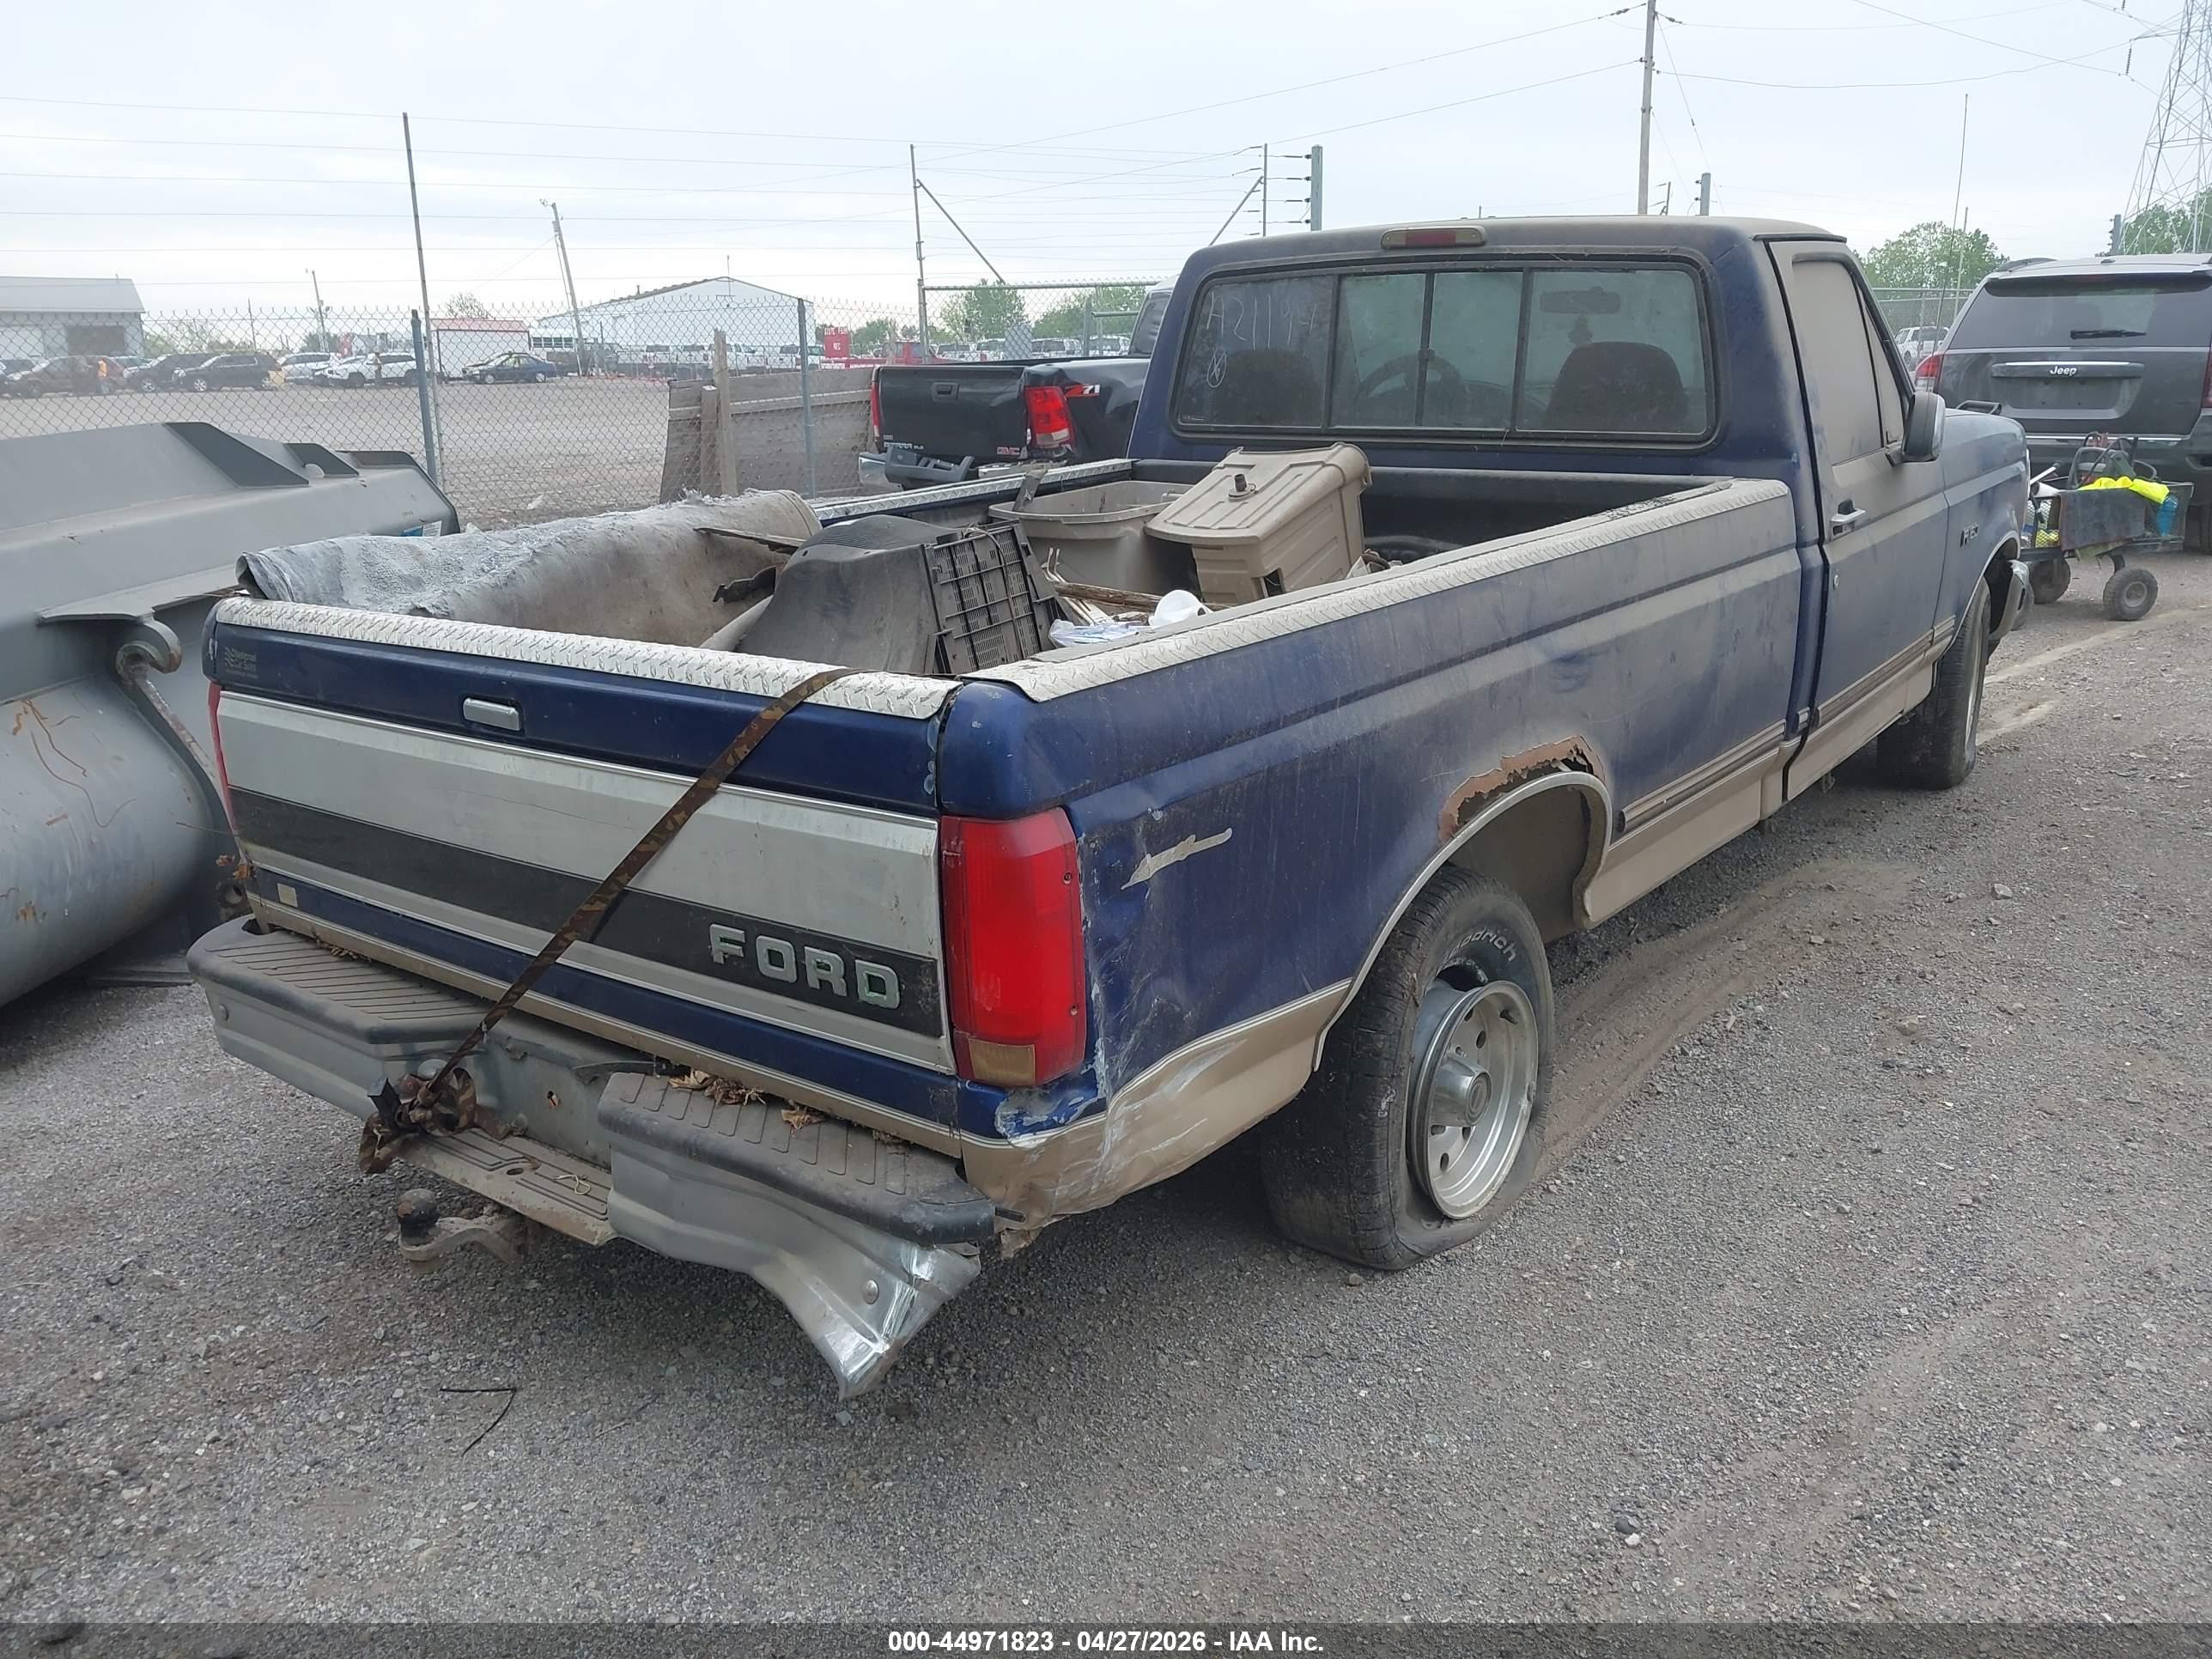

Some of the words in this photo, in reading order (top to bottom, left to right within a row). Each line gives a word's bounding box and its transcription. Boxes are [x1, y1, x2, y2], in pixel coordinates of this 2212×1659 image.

[2049, 365, 2077, 377] Jeep
[996, 446, 1020, 455] GMC
[709, 924, 900, 1009] FORD
